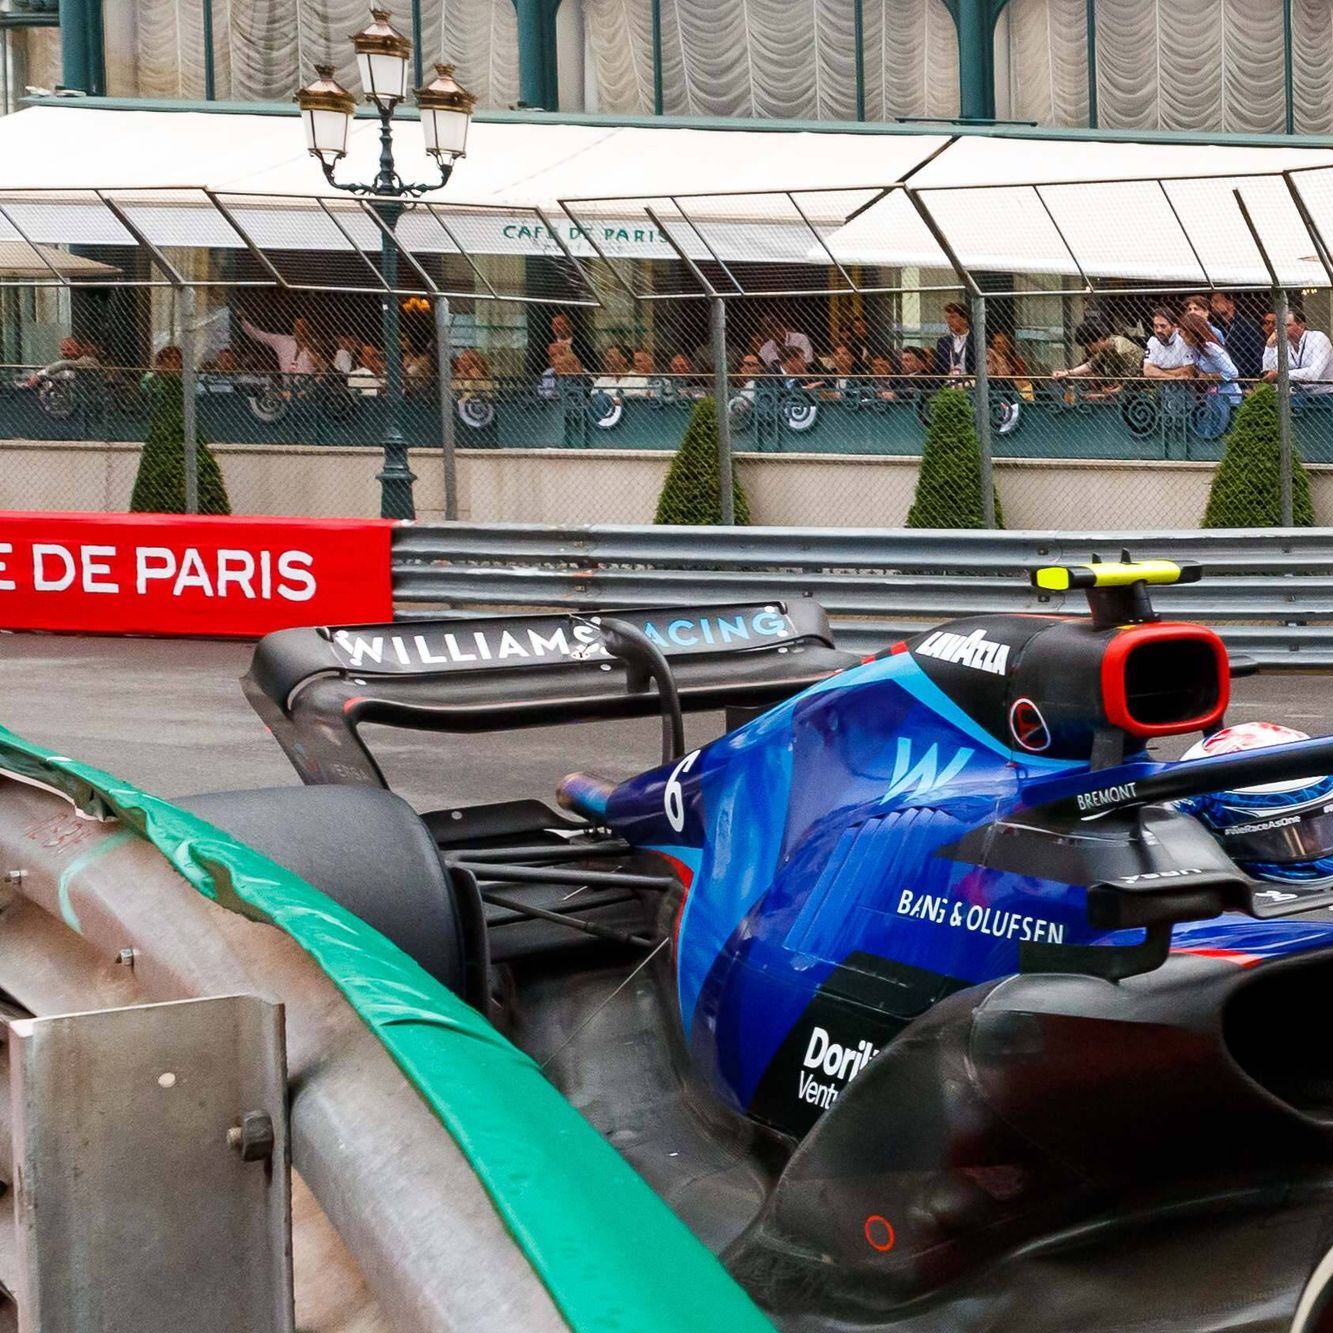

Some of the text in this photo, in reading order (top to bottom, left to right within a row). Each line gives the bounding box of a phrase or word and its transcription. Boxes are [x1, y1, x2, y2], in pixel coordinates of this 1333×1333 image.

[604, 228, 670, 243] PARIS
[32, 543, 120, 594] DE
[136, 546, 317, 602] PARIS
[338, 610, 786, 666] WILLIAMS ACING
[915, 629, 1011, 676] LAVAZZA
[664, 750, 701, 833] 6
[1077, 782, 1137, 811] BREMONT
[950, 901, 964, 927] &
